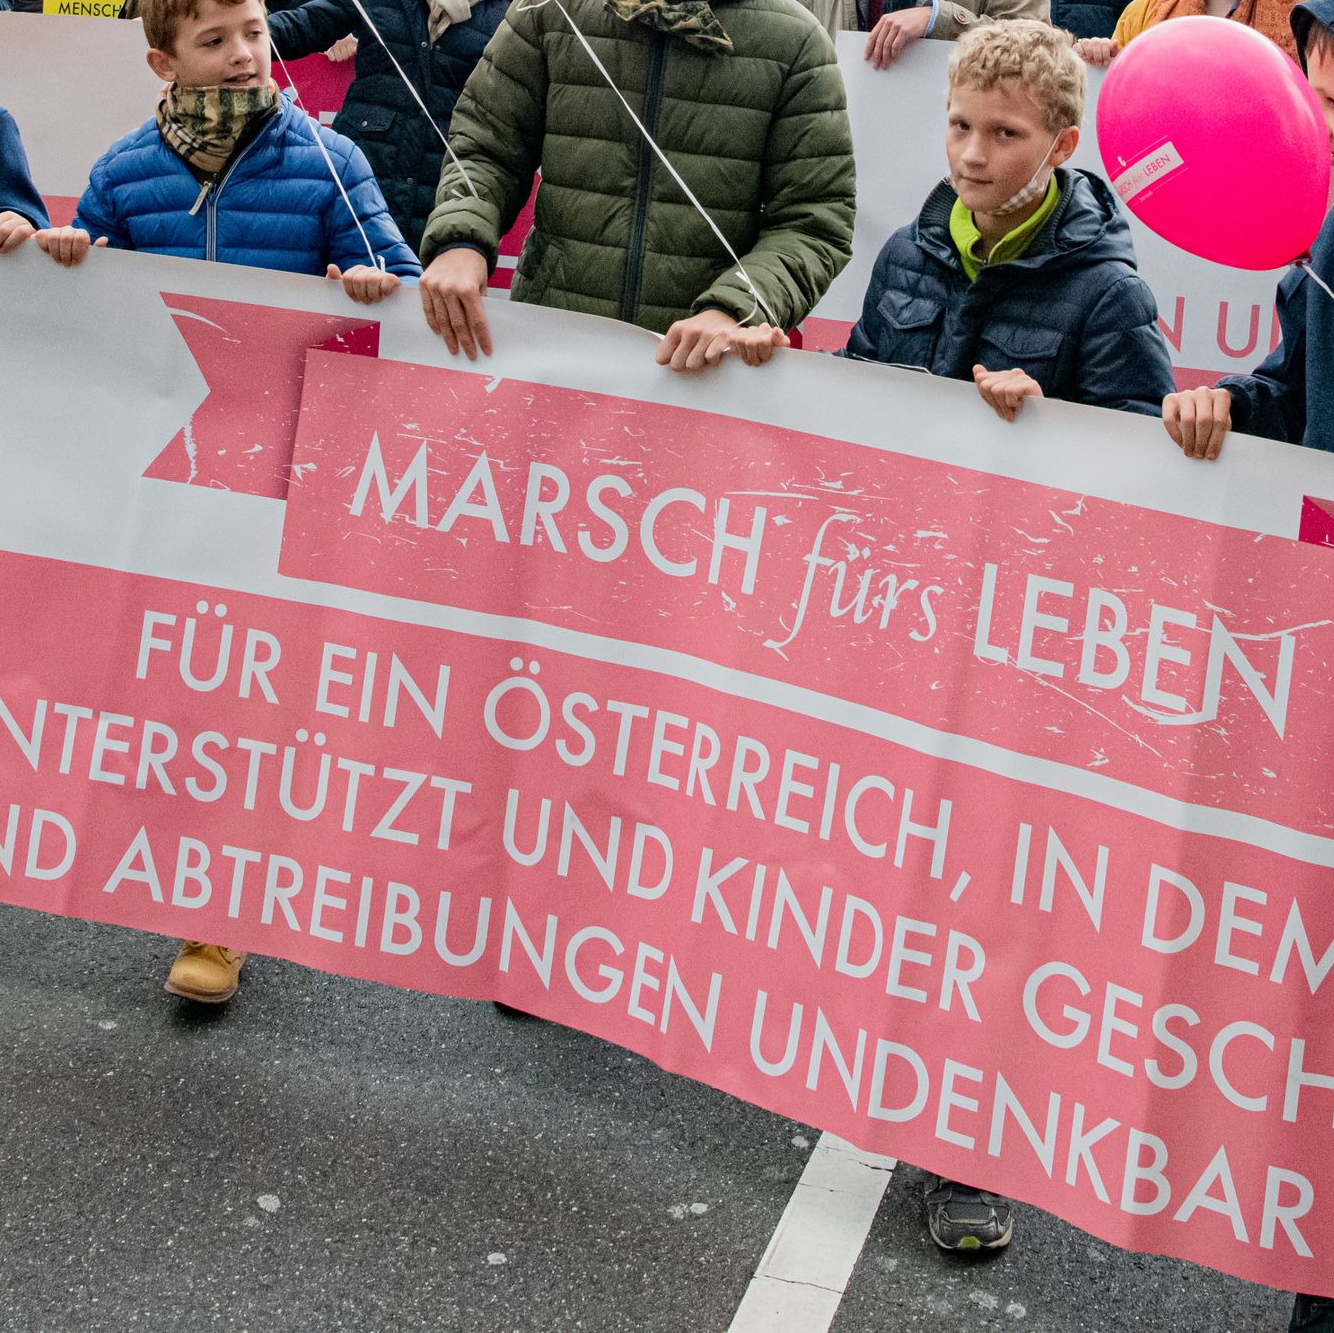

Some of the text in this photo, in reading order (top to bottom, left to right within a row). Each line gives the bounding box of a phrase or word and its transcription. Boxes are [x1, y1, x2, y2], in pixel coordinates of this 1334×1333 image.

[1143, 154, 1172, 177] LEBEN
[348, 429, 1296, 742] MARSCH fürs LEBEN
[135, 600, 282, 705] FÜR
[315, 642, 451, 739] EIN
[483, 656, 972, 903] ÖSTERREICH,
[1010, 822, 1110, 934] IN
[502, 788, 675, 901] UND
[690, 847, 987, 1023] KINDER
[102, 824, 723, 1054] ABTREIBUNGEN
[748, 989, 1316, 1259] UNDENKBAR
